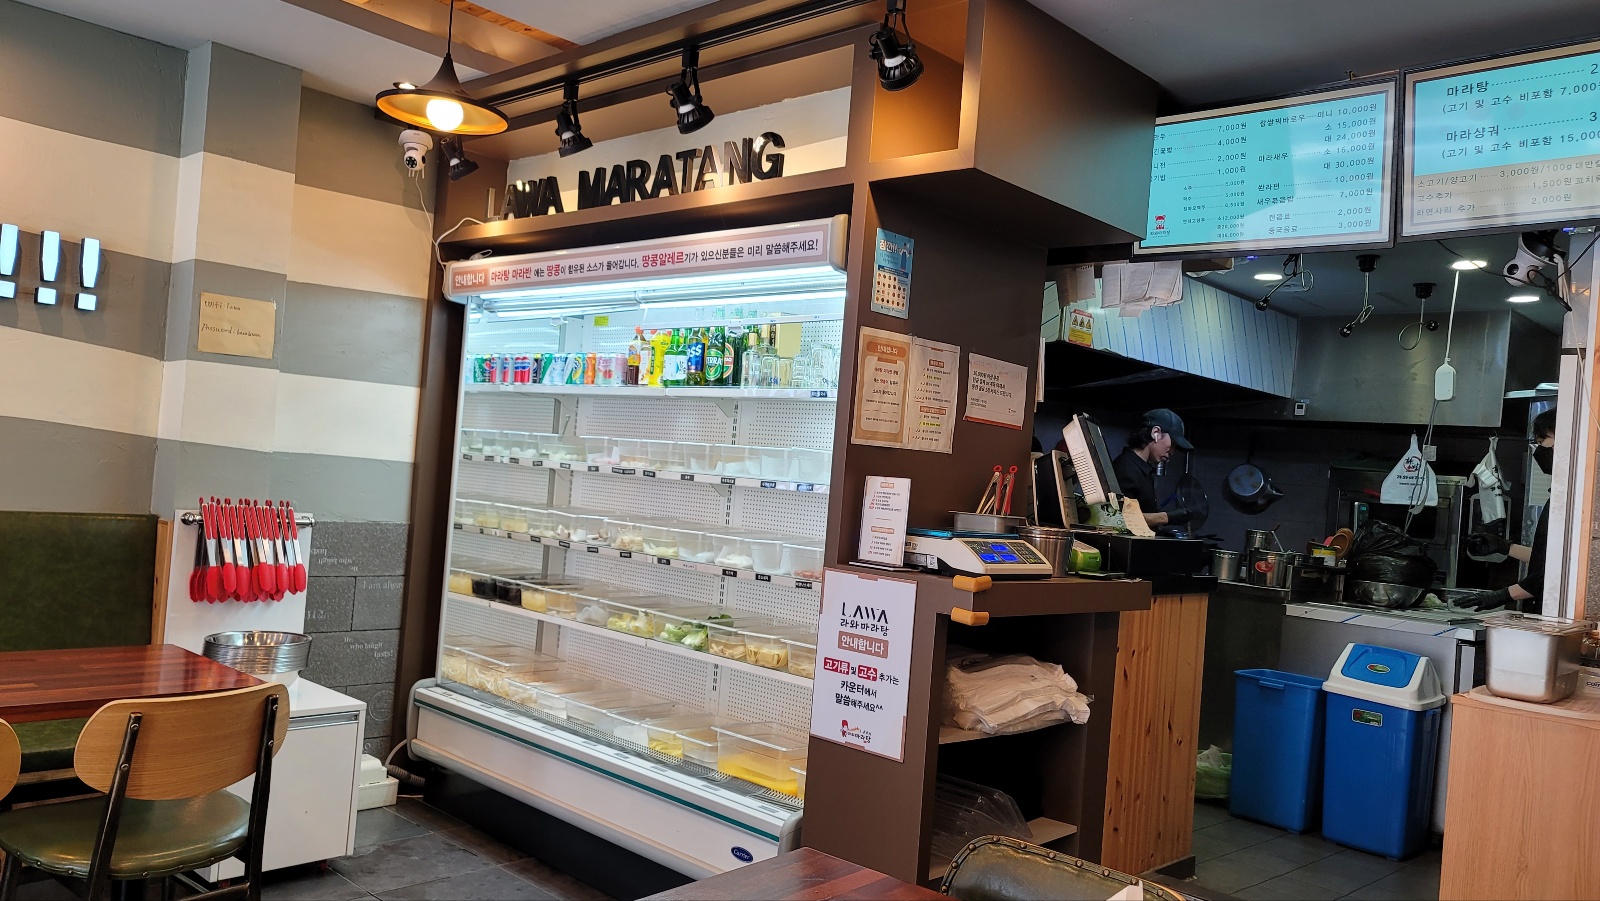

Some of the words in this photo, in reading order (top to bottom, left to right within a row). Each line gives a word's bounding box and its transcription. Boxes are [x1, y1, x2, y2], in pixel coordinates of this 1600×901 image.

[1447, 80, 1489, 97] 마라탕
[1442, 101, 1468, 114] (고기
[1475, 99, 1484, 109] 및
[1491, 95, 1512, 106] 고수
[1519, 88, 1553, 102] 비포함
[1317, 110, 1333, 118] 미니
[1338, 103, 1377, 116] 10,000원
[1217, 122, 1247, 132] 7,000원
[1337, 117, 1376, 129] 15,000원
[1217, 136, 1247, 146] 4,000원
[1325, 135, 1332, 143] 대
[1336, 129, 1376, 141] 24,000원
[1446, 125, 1499, 142] 마라샹궈
[1336, 142, 1375, 154] 16,000원
[1442, 147, 1467, 160] (고기
[1474, 145, 1484, 155] 및
[1490, 141, 1512, 152] 고수
[1519, 135, 1553, 149] 비포함
[1217, 152, 1247, 162] 2,000원
[1323, 161, 1331, 169] 대
[1335, 157, 1375, 168] 30,000원
[485, 176, 564, 222] LAWA
[577, 131, 786, 211] MARATANG
[1217, 165, 1246, 175] 1,000원
[1335, 172, 1374, 183] 10,000원
[1417, 173, 1478, 188] 소고기/양고기
[1339, 187, 1373, 198] 7,000원
[1417, 191, 1453, 203] 고수추가
[1532, 177, 1572, 190] 1,500원
[1338, 205, 1372, 217] 2,000원
[1416, 206, 1452, 217] 라면사리
[1457, 203, 1476, 213] 추가
[1531, 193, 1572, 205] 2,000원
[1338, 219, 1372, 230] 3,000원
[454, 272, 485, 287] 안내합니다
[490, 268, 510, 282] 마라탕
[533, 266, 545, 278] 에는
[546, 264, 566, 277] 땅콩이
[567, 263, 585, 275] 함유된
[586, 260, 605, 273] 소스가
[606, 258, 639, 271] 들어갑니다.
[641, 250, 699, 268] 땅콩알레르기가
[700, 246, 745, 262] 있으신분들은
[747, 244, 763, 257] 미리
[765, 238, 819, 255] 말씀해주세요!
[841, 602, 889, 624] LAWA
[840, 618, 890, 637] 라와마라탕
[841, 635, 885, 655] 안내합니다
[824, 658, 850, 675] 고기류
[850, 666, 857, 676] 및
[858, 666, 877, 681] 고수
[879, 673, 900, 686] 추가는
[840, 680, 877, 699] 카운터에서
[733, 848, 750, 860] Carrier
